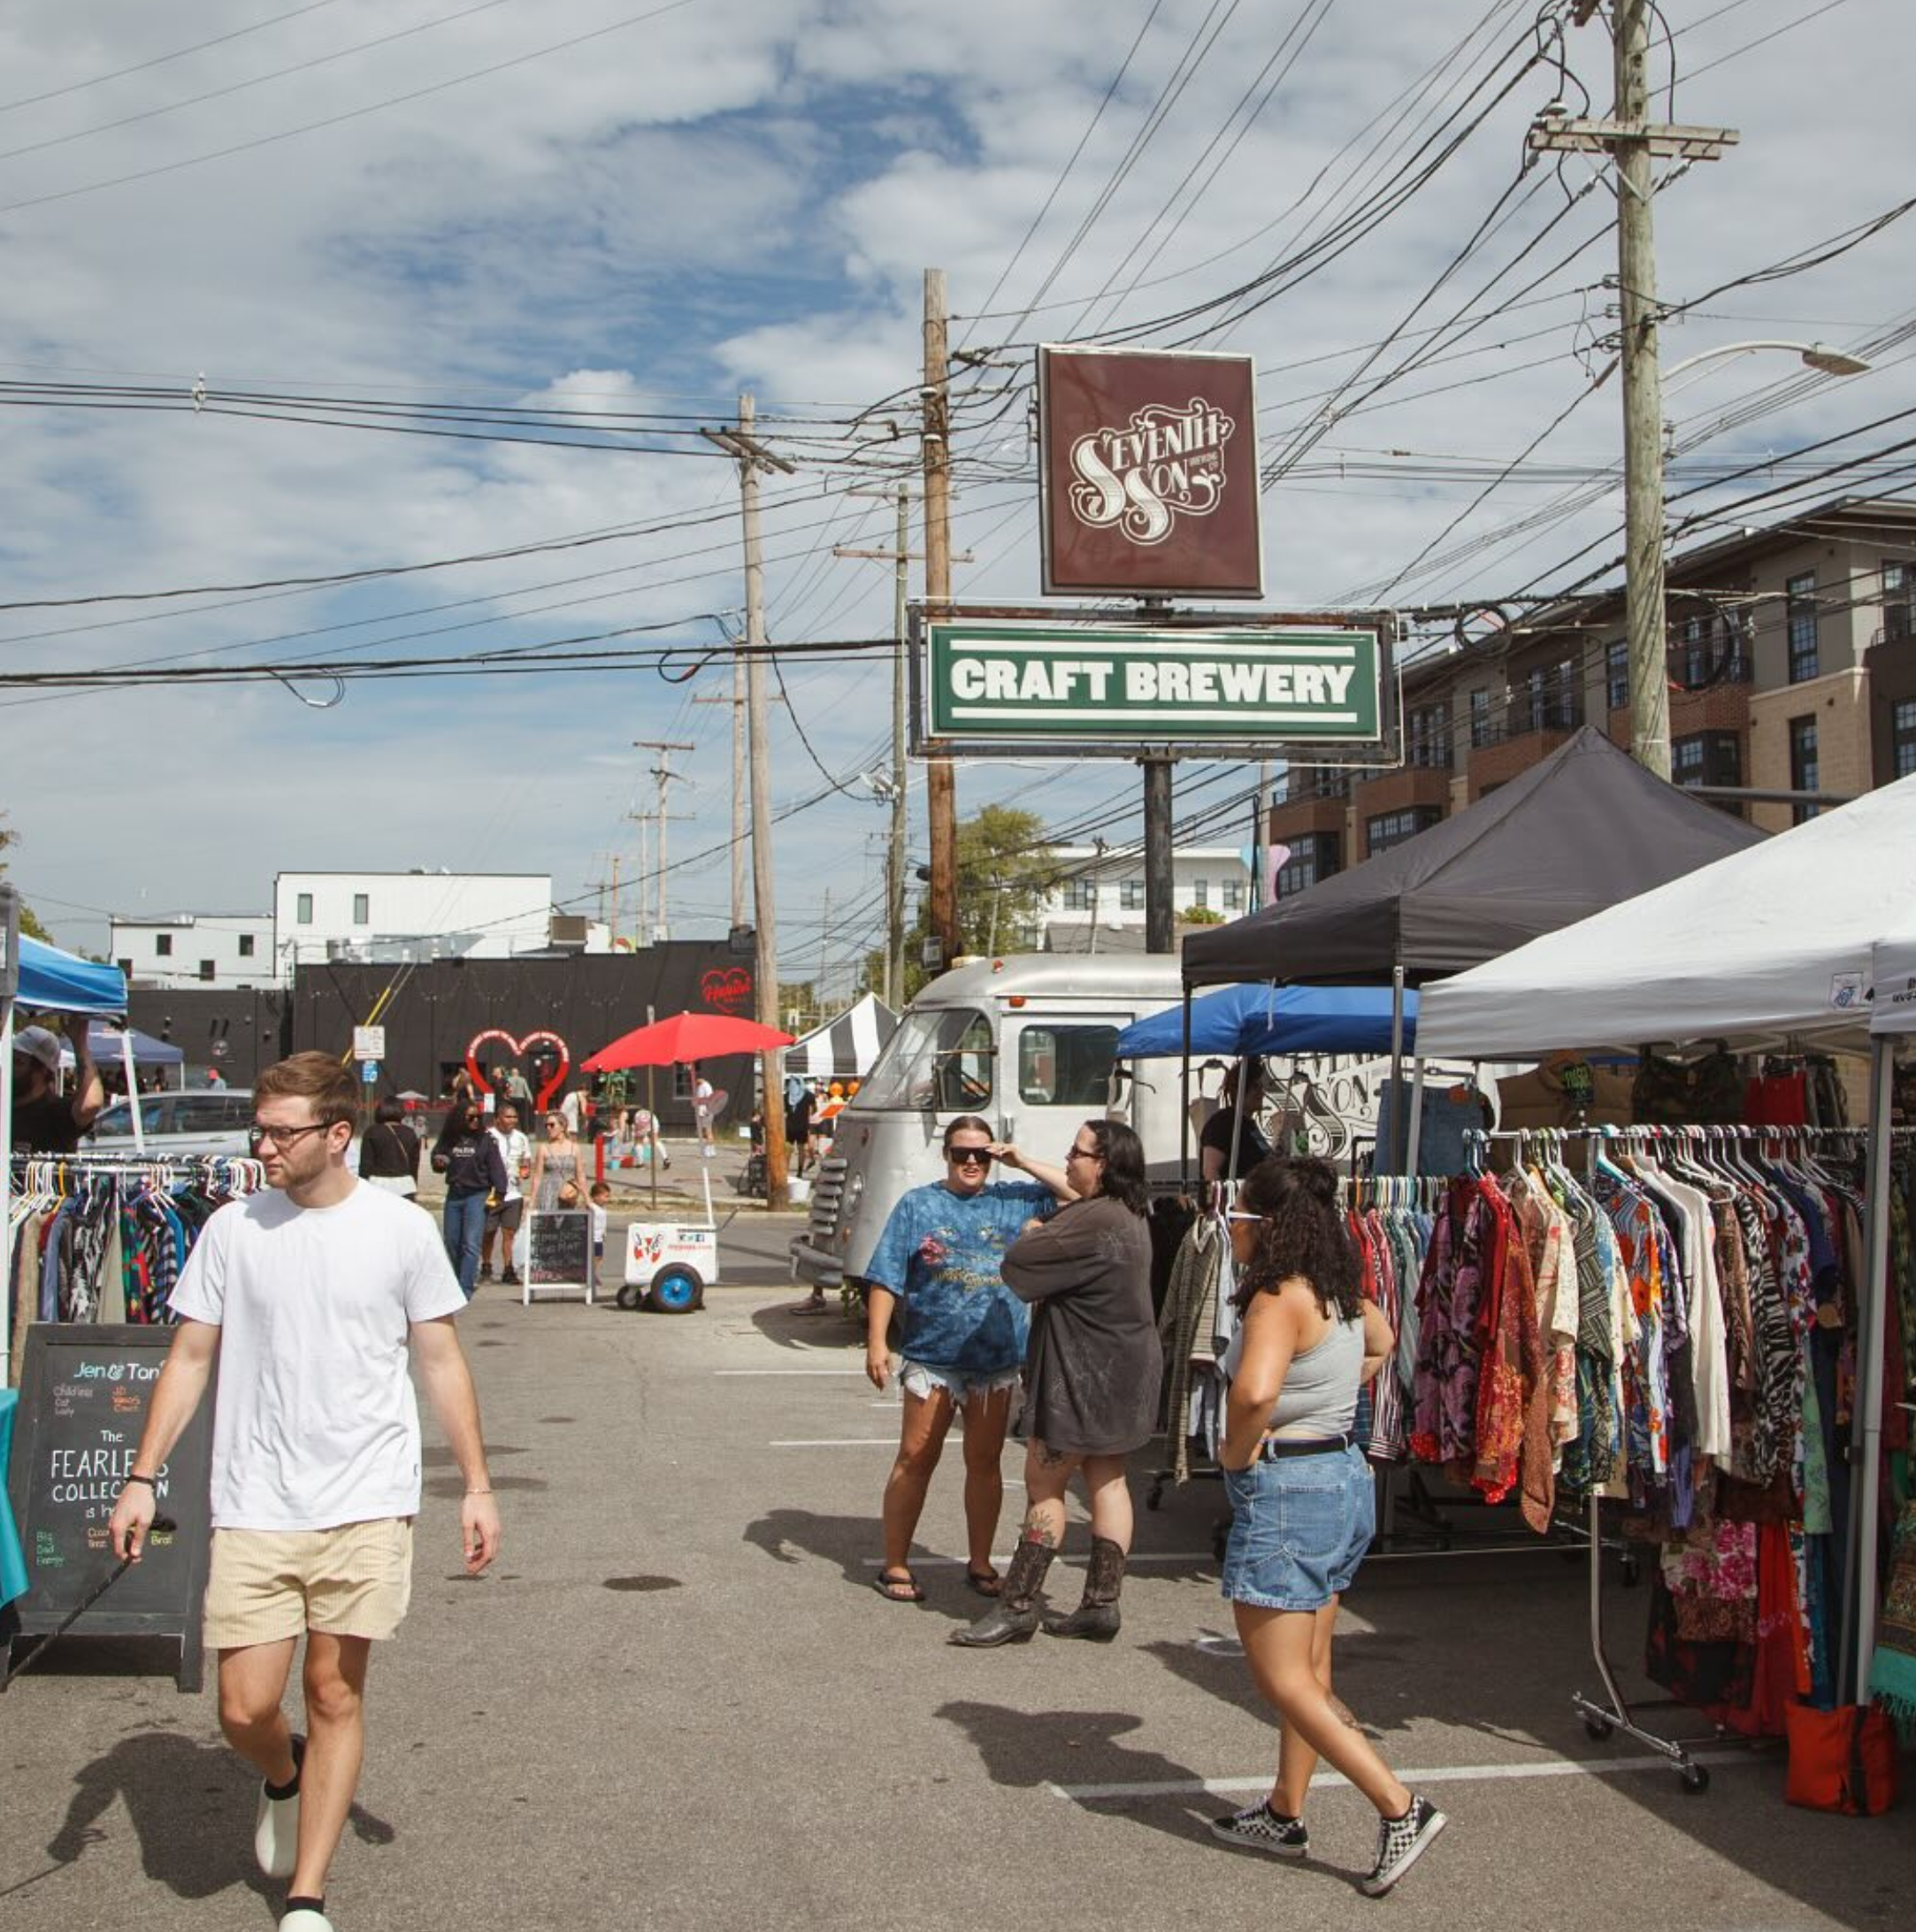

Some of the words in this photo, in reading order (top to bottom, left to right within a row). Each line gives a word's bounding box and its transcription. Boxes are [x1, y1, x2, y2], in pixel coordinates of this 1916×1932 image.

[1075, 403, 1230, 522] SEVENTH
[1124, 459, 1190, 540] SON
[950, 658, 1114, 701] CRAFT
[1125, 661, 1356, 704] BREWERY
[73, 1361, 106, 1378] Jen
[100, 1430, 124, 1443] The
[51, 1449, 169, 1478] FEARLES
[52, 1479, 169, 1503] COLLECN
